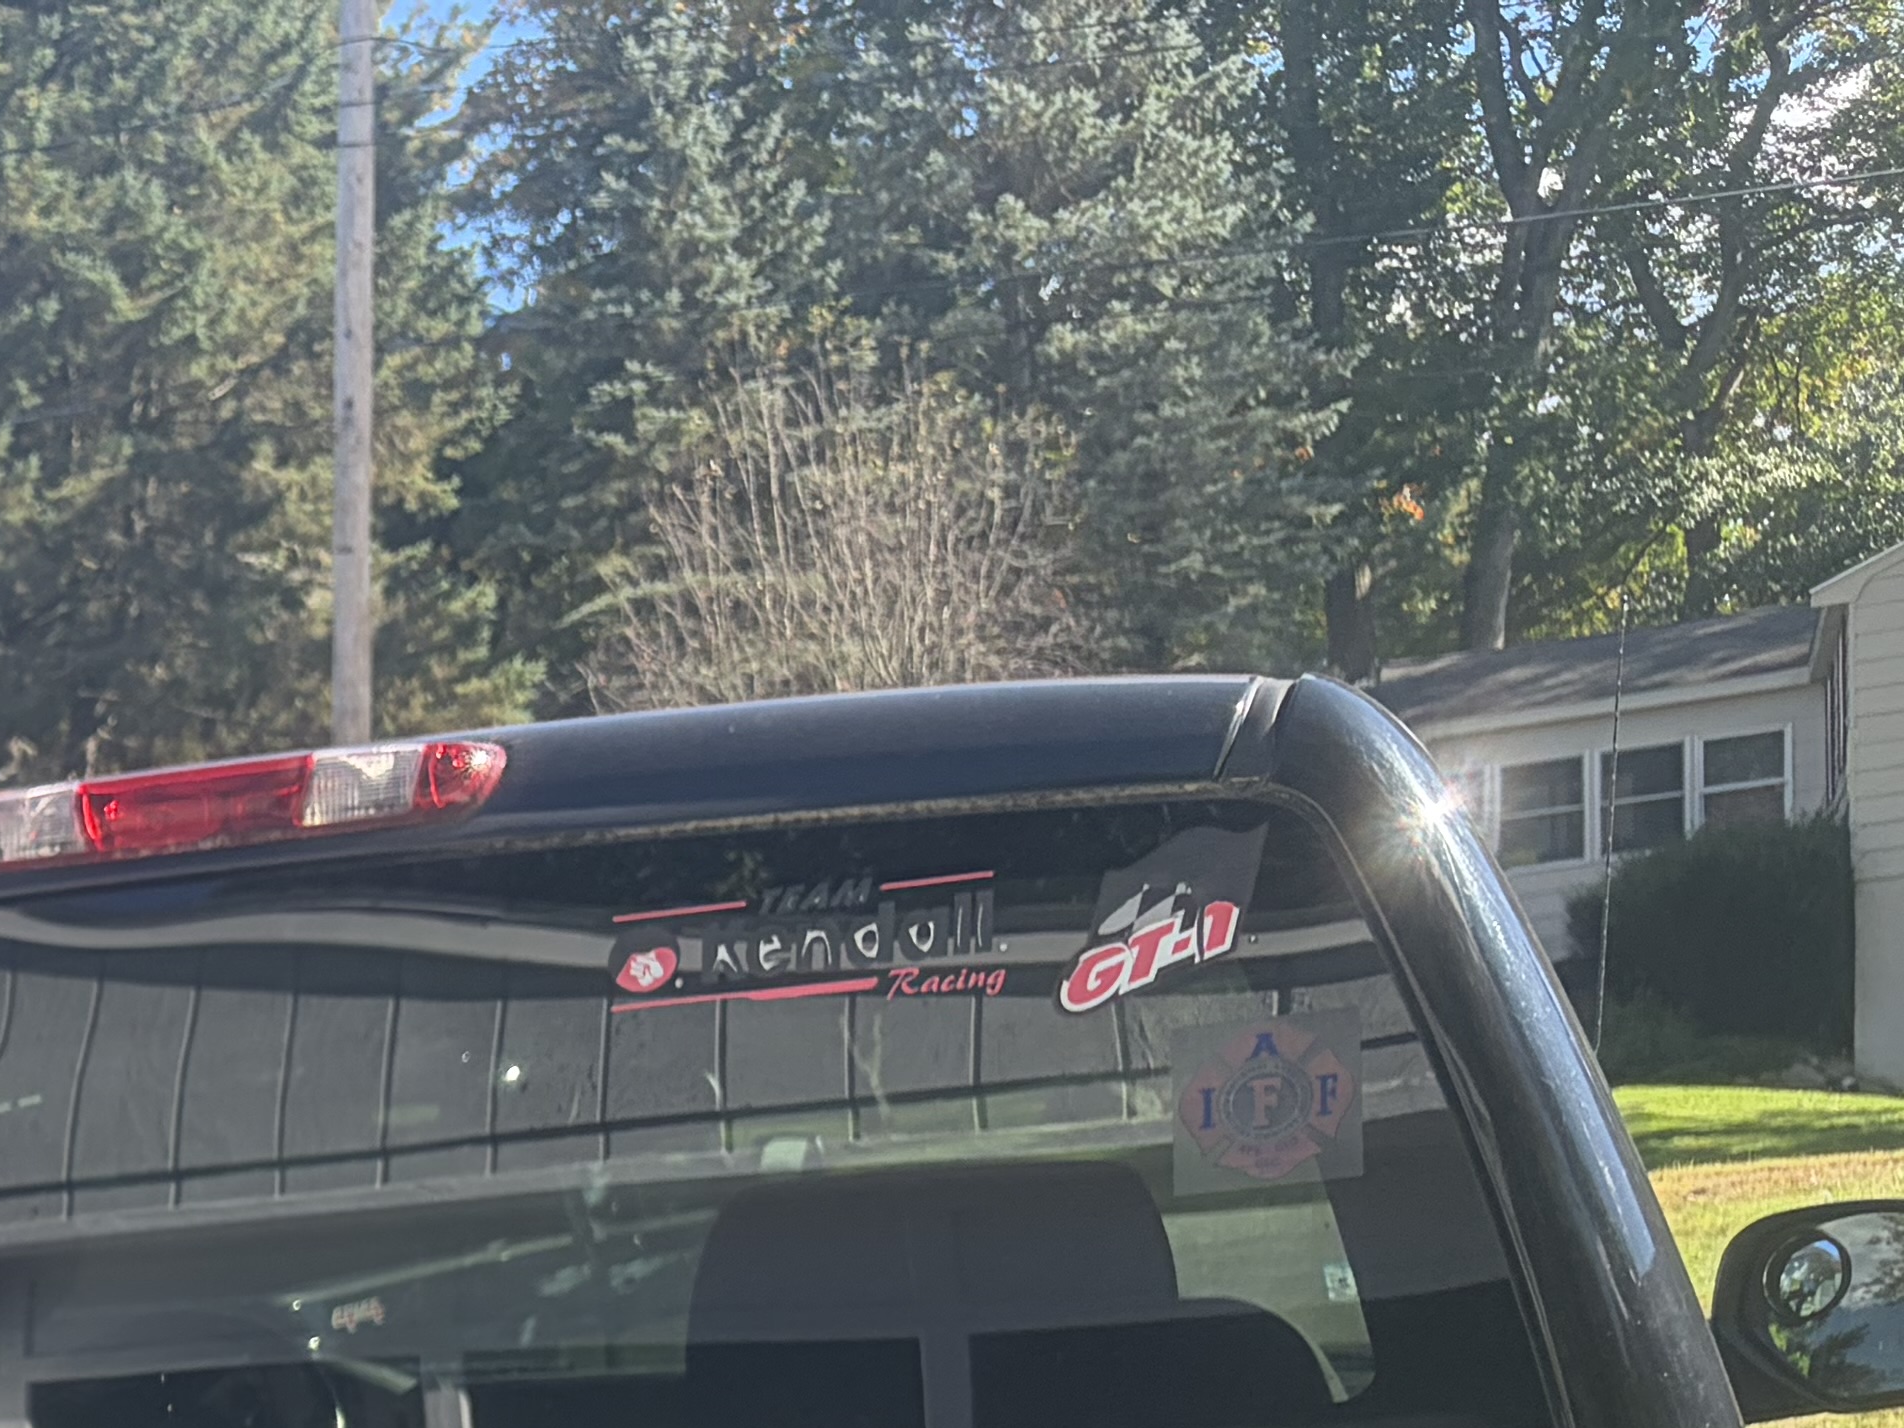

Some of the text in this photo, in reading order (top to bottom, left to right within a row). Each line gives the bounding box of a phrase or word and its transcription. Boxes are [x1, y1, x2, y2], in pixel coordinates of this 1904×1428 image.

[698, 891, 993, 982] Kendall
[1059, 900, 1240, 1012] GT-1
[887, 967, 1005, 1000] Racing
